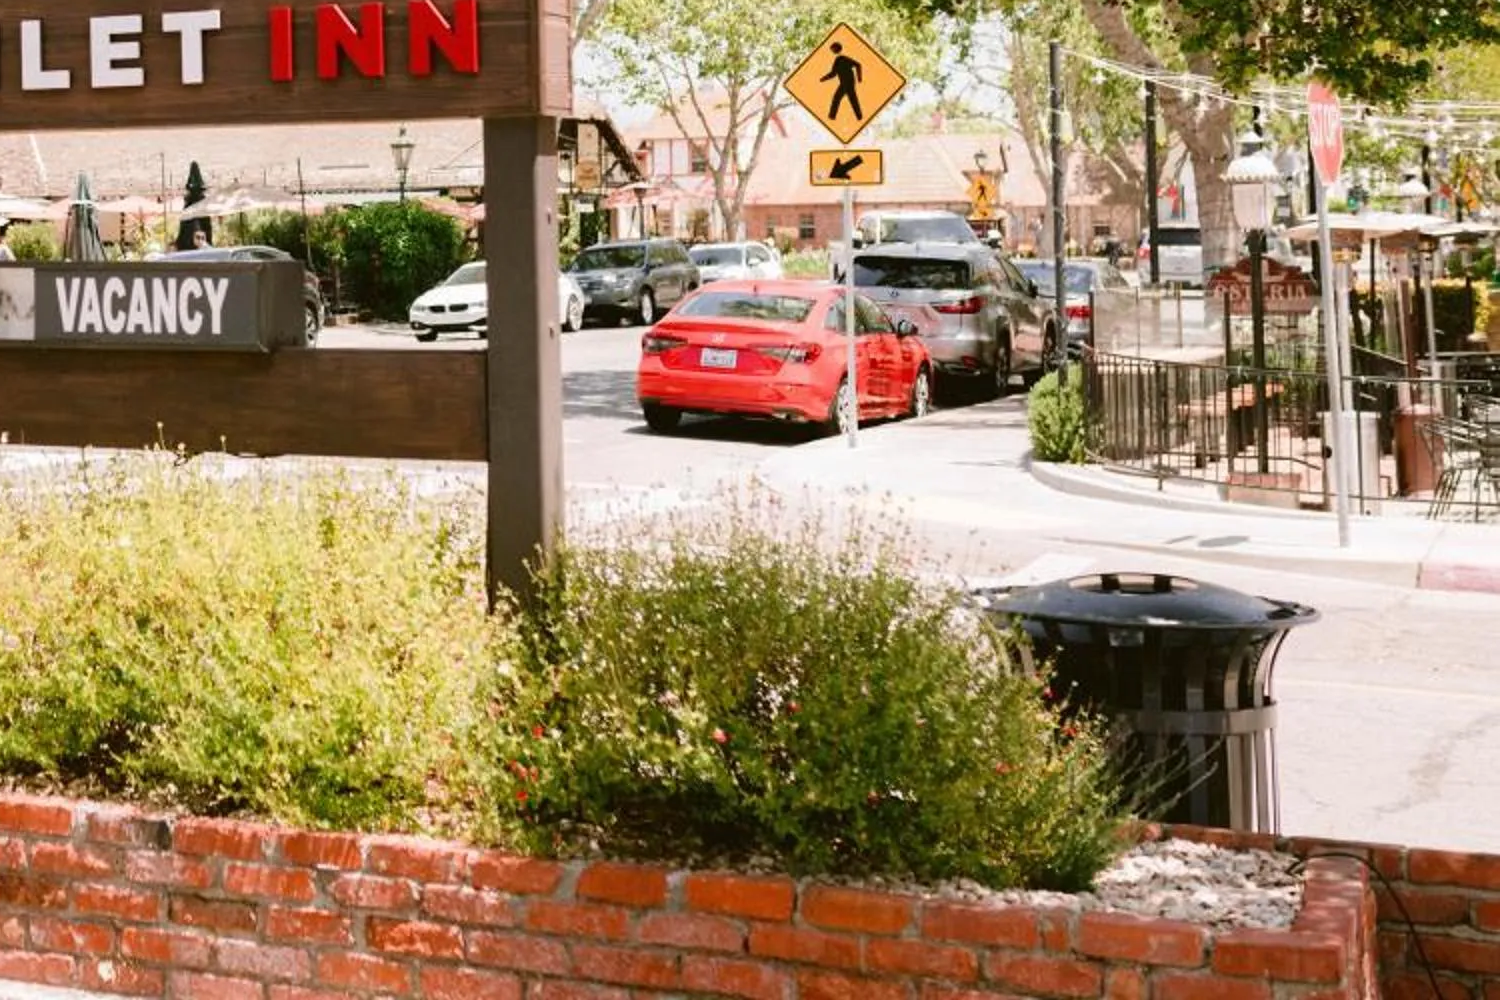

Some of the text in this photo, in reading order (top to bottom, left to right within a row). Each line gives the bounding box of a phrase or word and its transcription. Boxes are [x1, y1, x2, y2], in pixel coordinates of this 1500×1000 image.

[1311, 103, 1341, 147] STOP
[55, 276, 230, 335] VACANCY
[1212, 282, 1308, 302] OSTRIA
